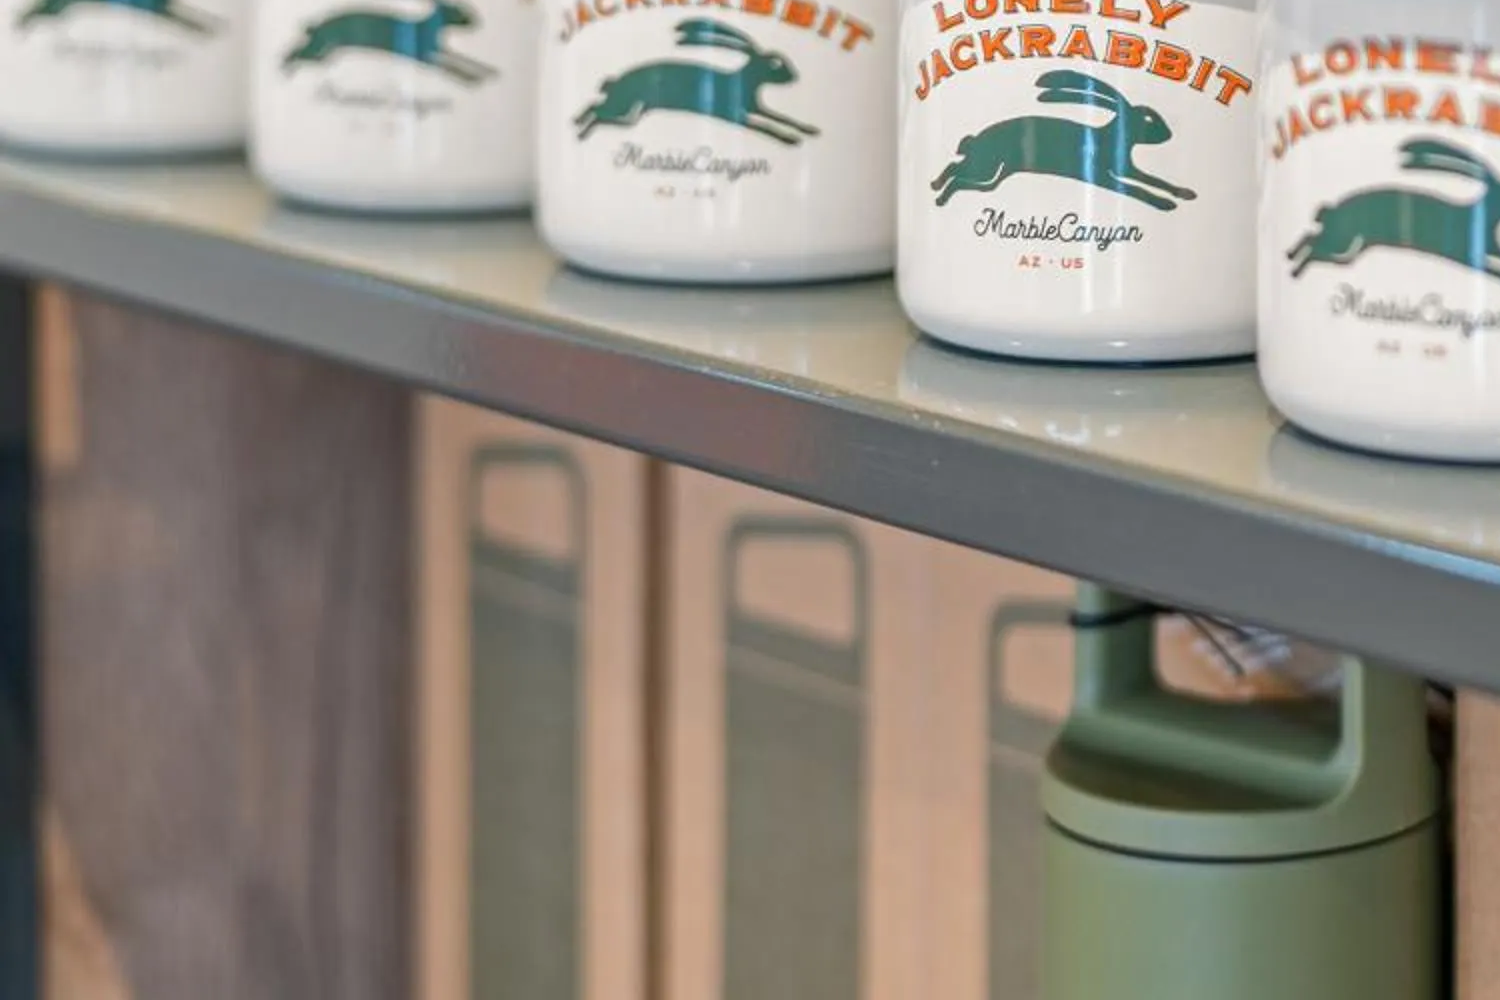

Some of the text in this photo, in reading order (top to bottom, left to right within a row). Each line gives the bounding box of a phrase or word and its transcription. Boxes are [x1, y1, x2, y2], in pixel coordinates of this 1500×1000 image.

[914, 24, 1253, 106] JACKRABBIT
[973, 208, 1143, 252] MarbleCanyon
[1018, 255, 1085, 269] AZ US
